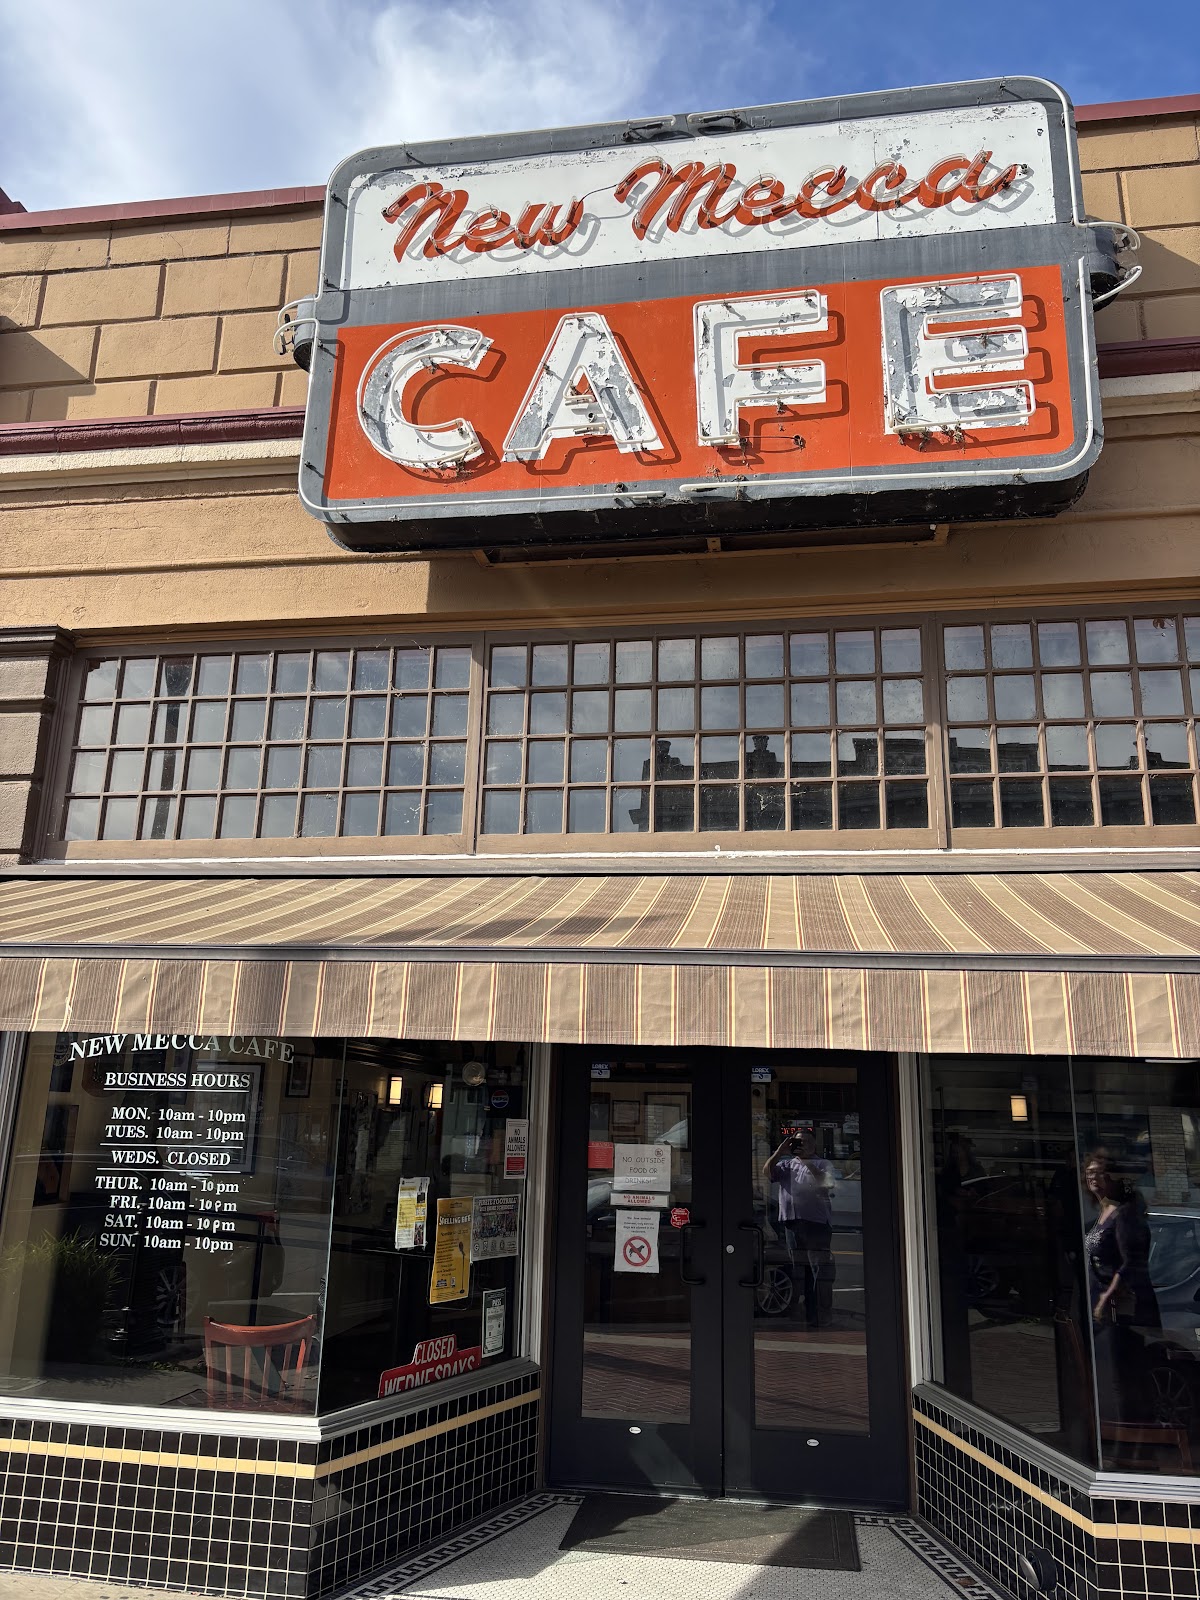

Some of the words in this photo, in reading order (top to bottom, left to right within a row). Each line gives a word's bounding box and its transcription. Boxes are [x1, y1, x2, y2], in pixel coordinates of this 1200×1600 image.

[381, 180, 586, 264] New
[612, 149, 1027, 241] Mecca
[357, 272, 1036, 471] CAFE
[68, 1034, 128, 1062] NEW
[130, 1034, 222, 1052] MECCA
[228, 1035, 296, 1064] CAFE
[104, 1072, 187, 1087] BUSINESS
[190, 1073, 250, 1088] HOURS
[111, 1106, 151, 1120] MON.
[158, 1108, 195, 1121] 10am
[207, 1109, 246, 1125] 10pm
[105, 1125, 149, 1138] TUES.
[156, 1126, 193, 1139] 10am
[205, 1127, 244, 1143] 10pm
[111, 1150, 159, 1164] WEDS.
[167, 1151, 231, 1166] CLOSED
[95, 1176, 142, 1190] THUR.
[150, 1178, 188, 1191] 10am
[109, 1195, 141, 1209] FRI.
[147, 1197, 186, 1210] 10am
[104, 1214, 138, 1228] SAT.
[145, 1216, 184, 1230] 10am
[439, 1215, 461, 1226] SPELLING
[100, 1233, 136, 1247] SUN.
[143, 1235, 181, 1249] 10am
[194, 1236, 234, 1253] 10pm
[414, 1336, 455, 1366] CLOSED
